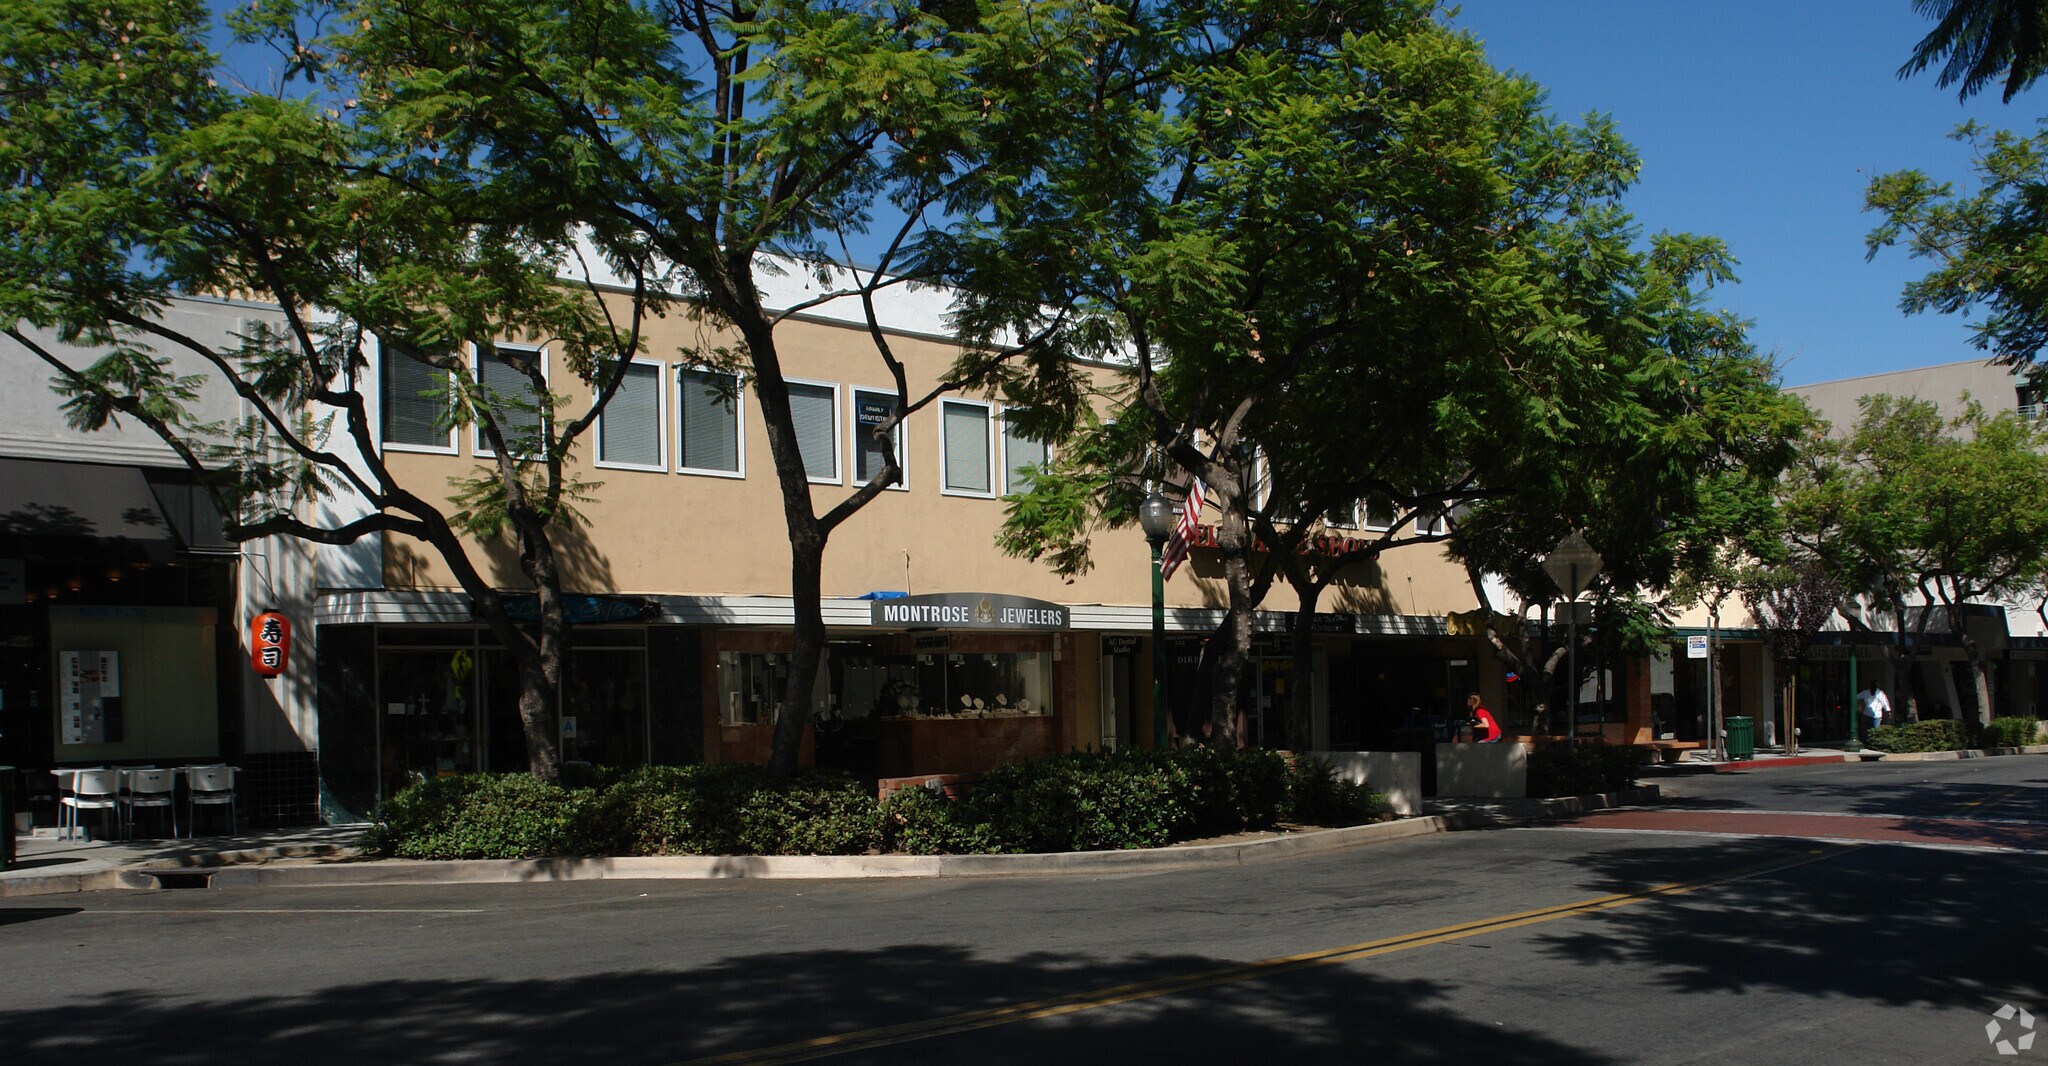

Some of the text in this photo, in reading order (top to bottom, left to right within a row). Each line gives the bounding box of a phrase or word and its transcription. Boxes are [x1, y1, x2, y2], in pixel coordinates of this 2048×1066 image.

[866, 405, 884, 413] FAMILY
[860, 414, 888, 423] DENTISTR
[884, 604, 1062, 626] MONTROSE JEWELERS
[260, 617, 283, 669] 寿司
[1108, 637, 1137, 646] AG Dental
[1113, 645, 1131, 654] Studio
[564, 721, 574, 732] A
